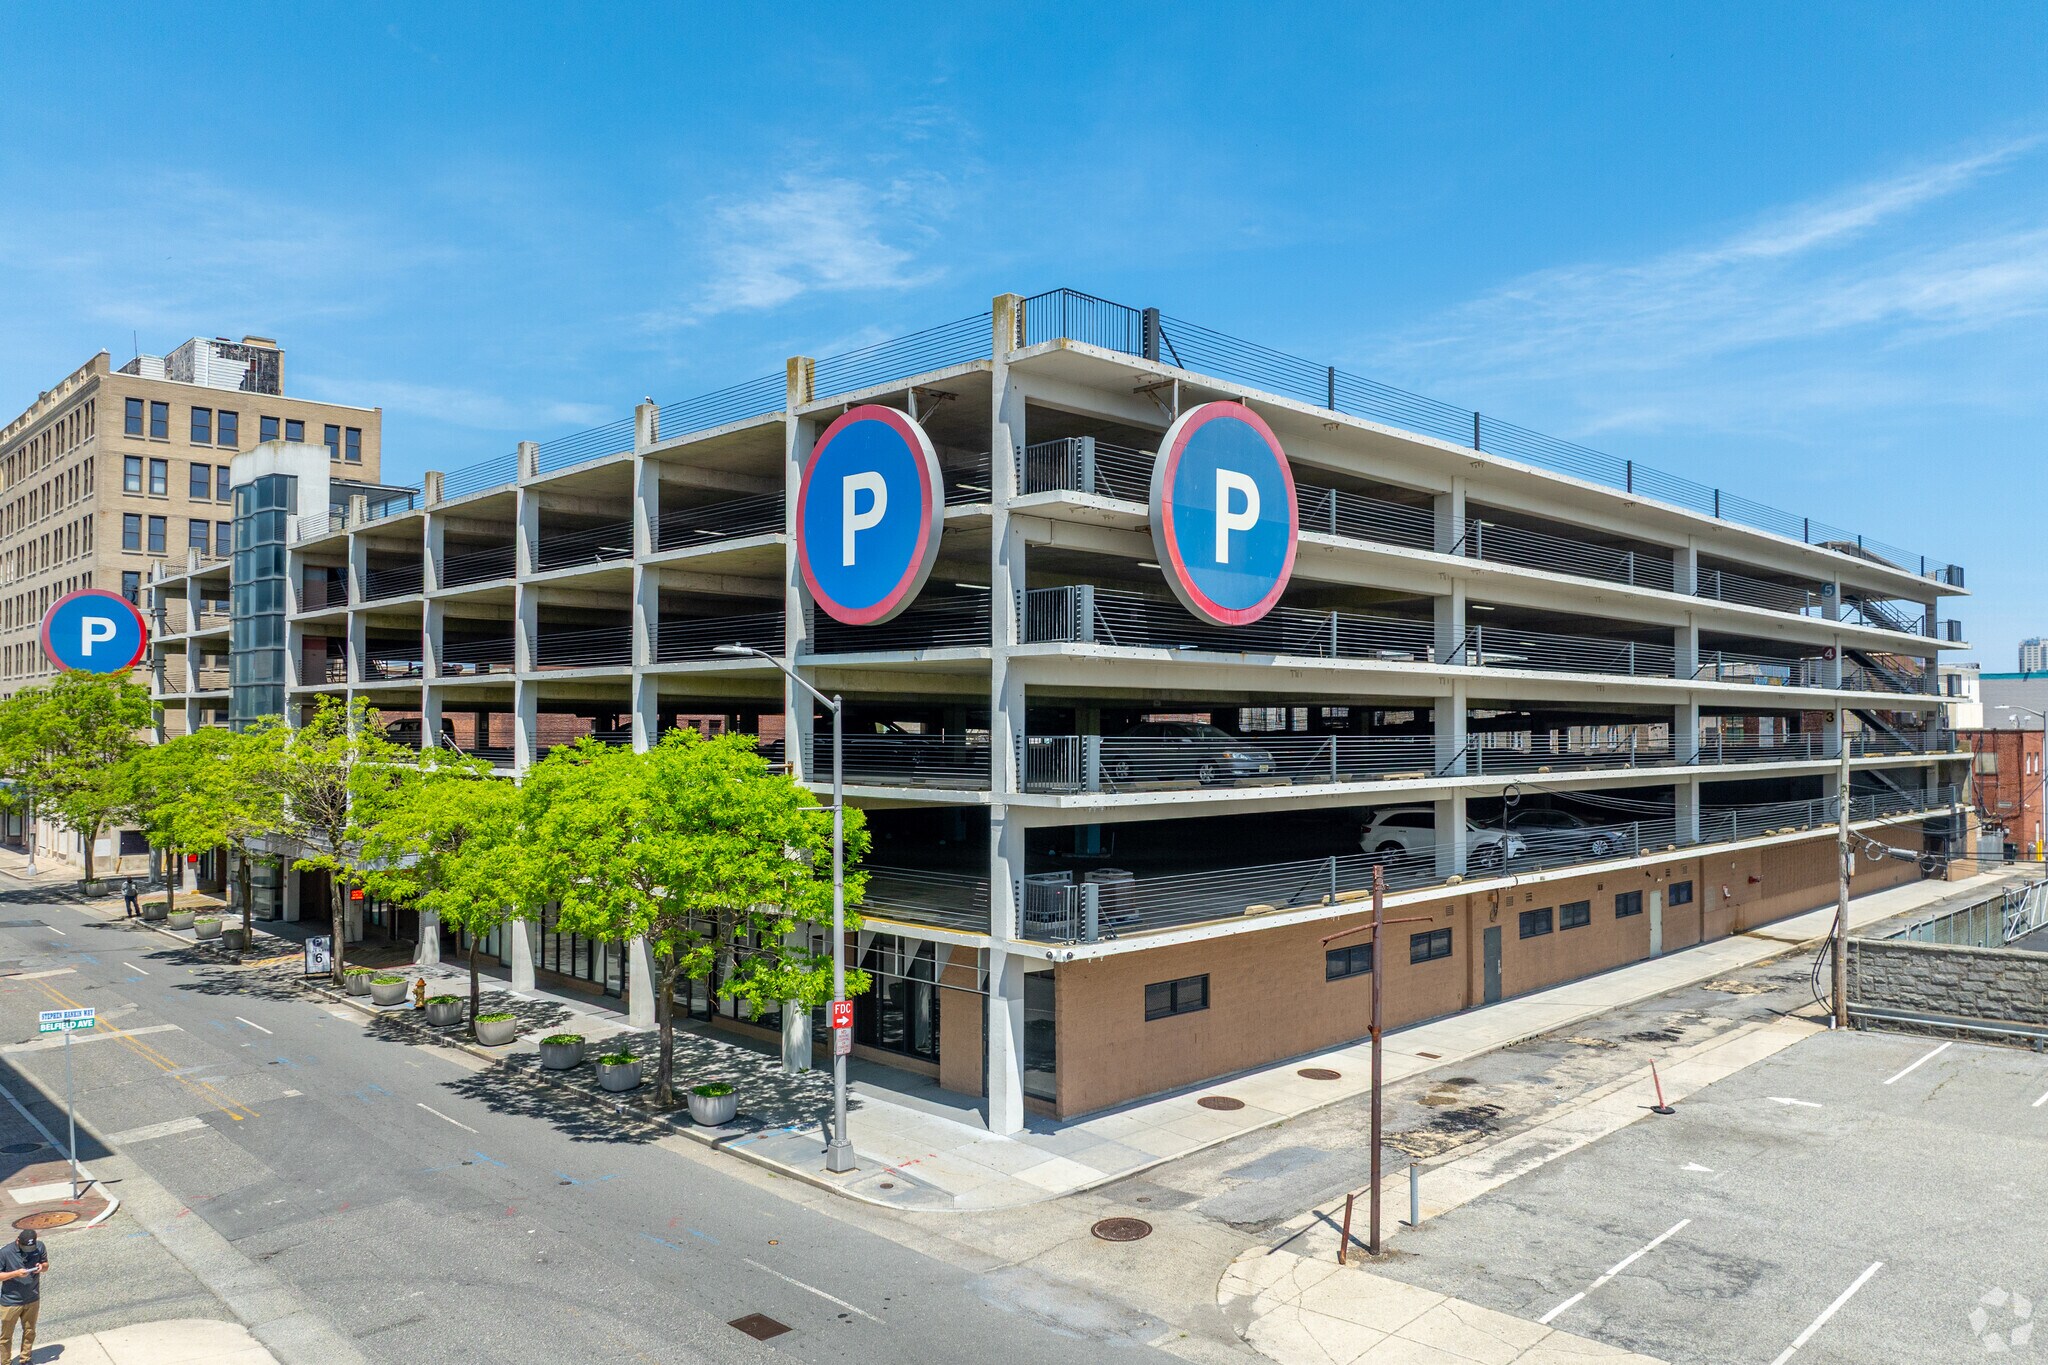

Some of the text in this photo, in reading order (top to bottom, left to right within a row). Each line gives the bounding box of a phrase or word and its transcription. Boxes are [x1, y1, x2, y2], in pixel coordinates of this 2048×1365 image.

[843, 471, 887, 567] P
[1215, 468, 1260, 564] P
[1824, 585, 1833, 597] 5
[81, 616, 117, 656] P
[1824, 648, 1834, 659] 4
[1825, 711, 1835, 723] 3
[834, 1003, 851, 1014] FDC
[40, 1019, 94, 1031] BELFIELD AVE
